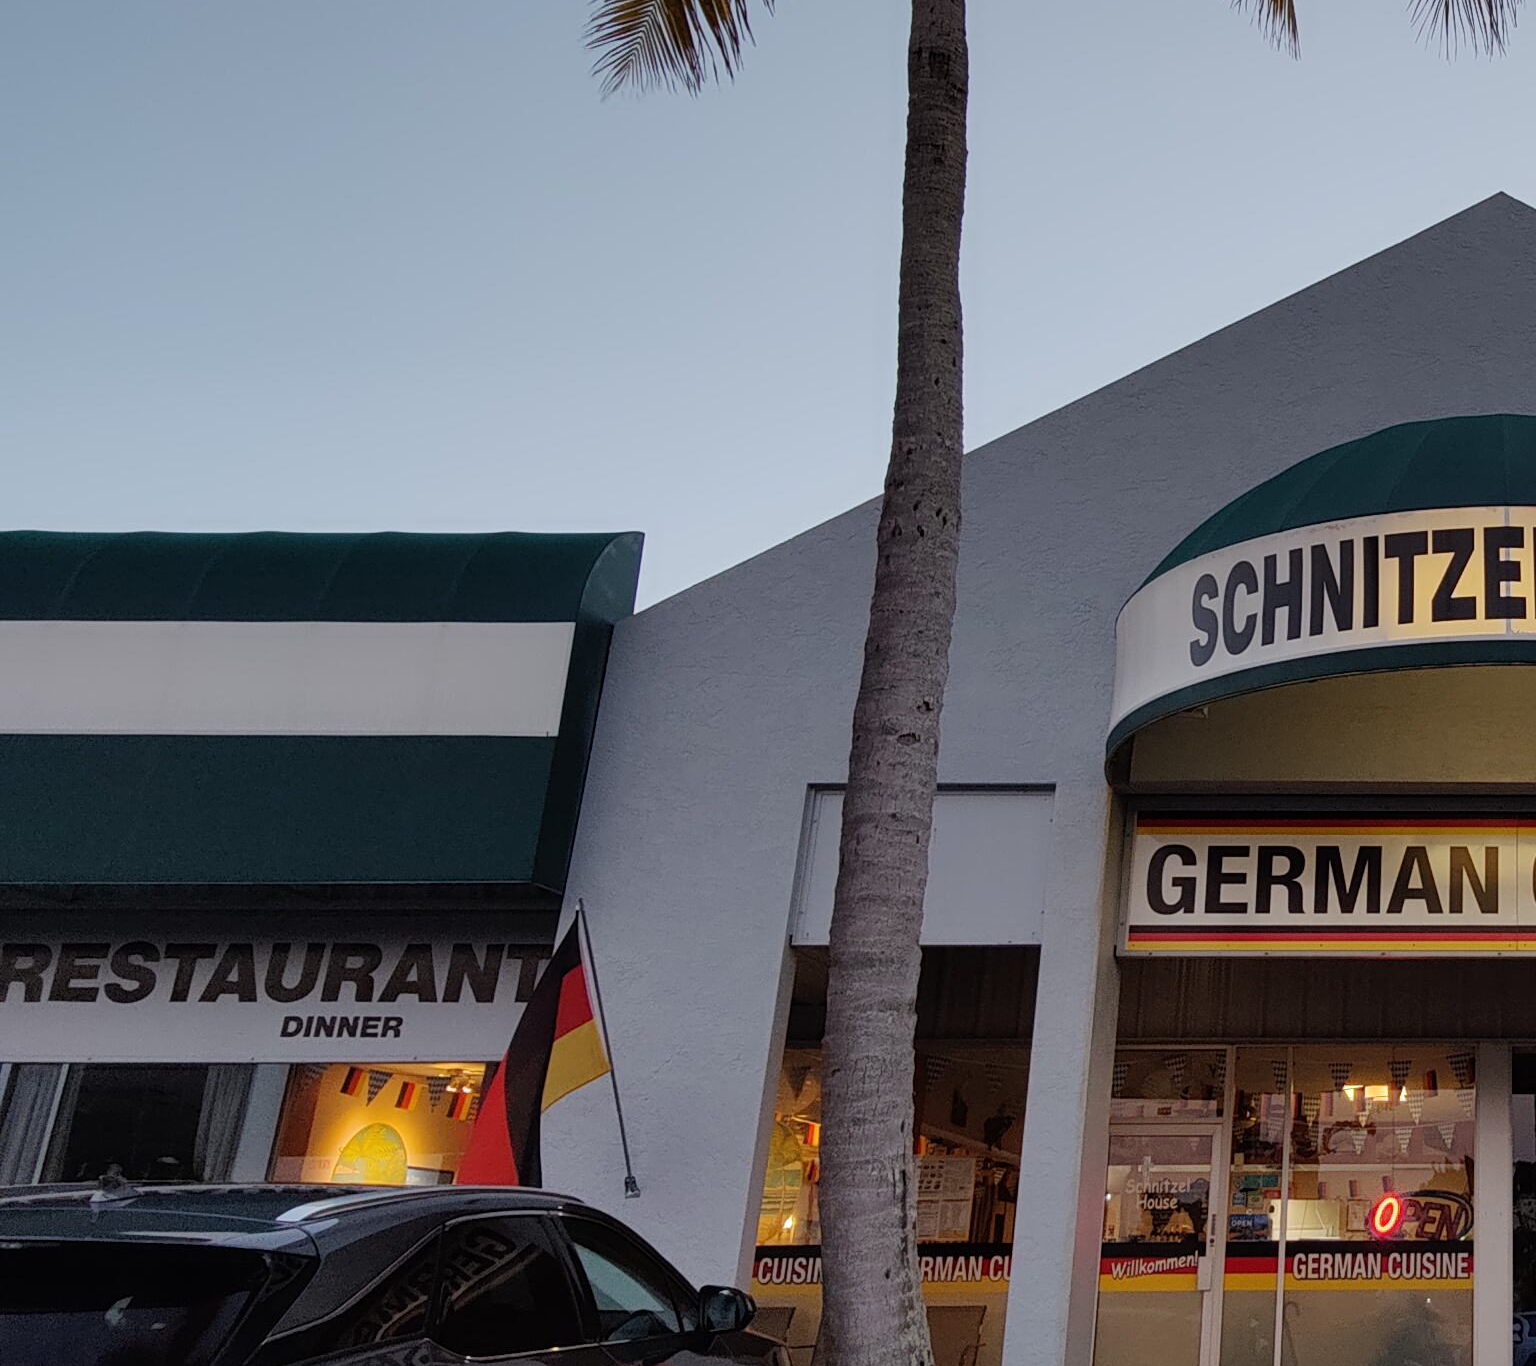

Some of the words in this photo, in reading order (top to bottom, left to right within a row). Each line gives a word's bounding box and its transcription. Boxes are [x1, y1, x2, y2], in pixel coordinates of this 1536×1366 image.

[1146, 843, 1499, 916] GERMAN
[0, 941, 555, 1005] RESTAURANT
[280, 1015, 404, 1039] DINNER
[1125, 1176, 1191, 1194] Schnitzel
[1136, 1194, 1179, 1210] House
[1231, 1219, 1253, 1227] OPEN
[1373, 1194, 1463, 1241] OPEN
[757, 1256, 823, 1284] CUISIN
[919, 1255, 984, 1282] RMAN
[1111, 1249, 1199, 1280] Willkommen!
[1292, 1252, 1382, 1280] GERMAN
[1387, 1251, 1470, 1280] CUISINE
